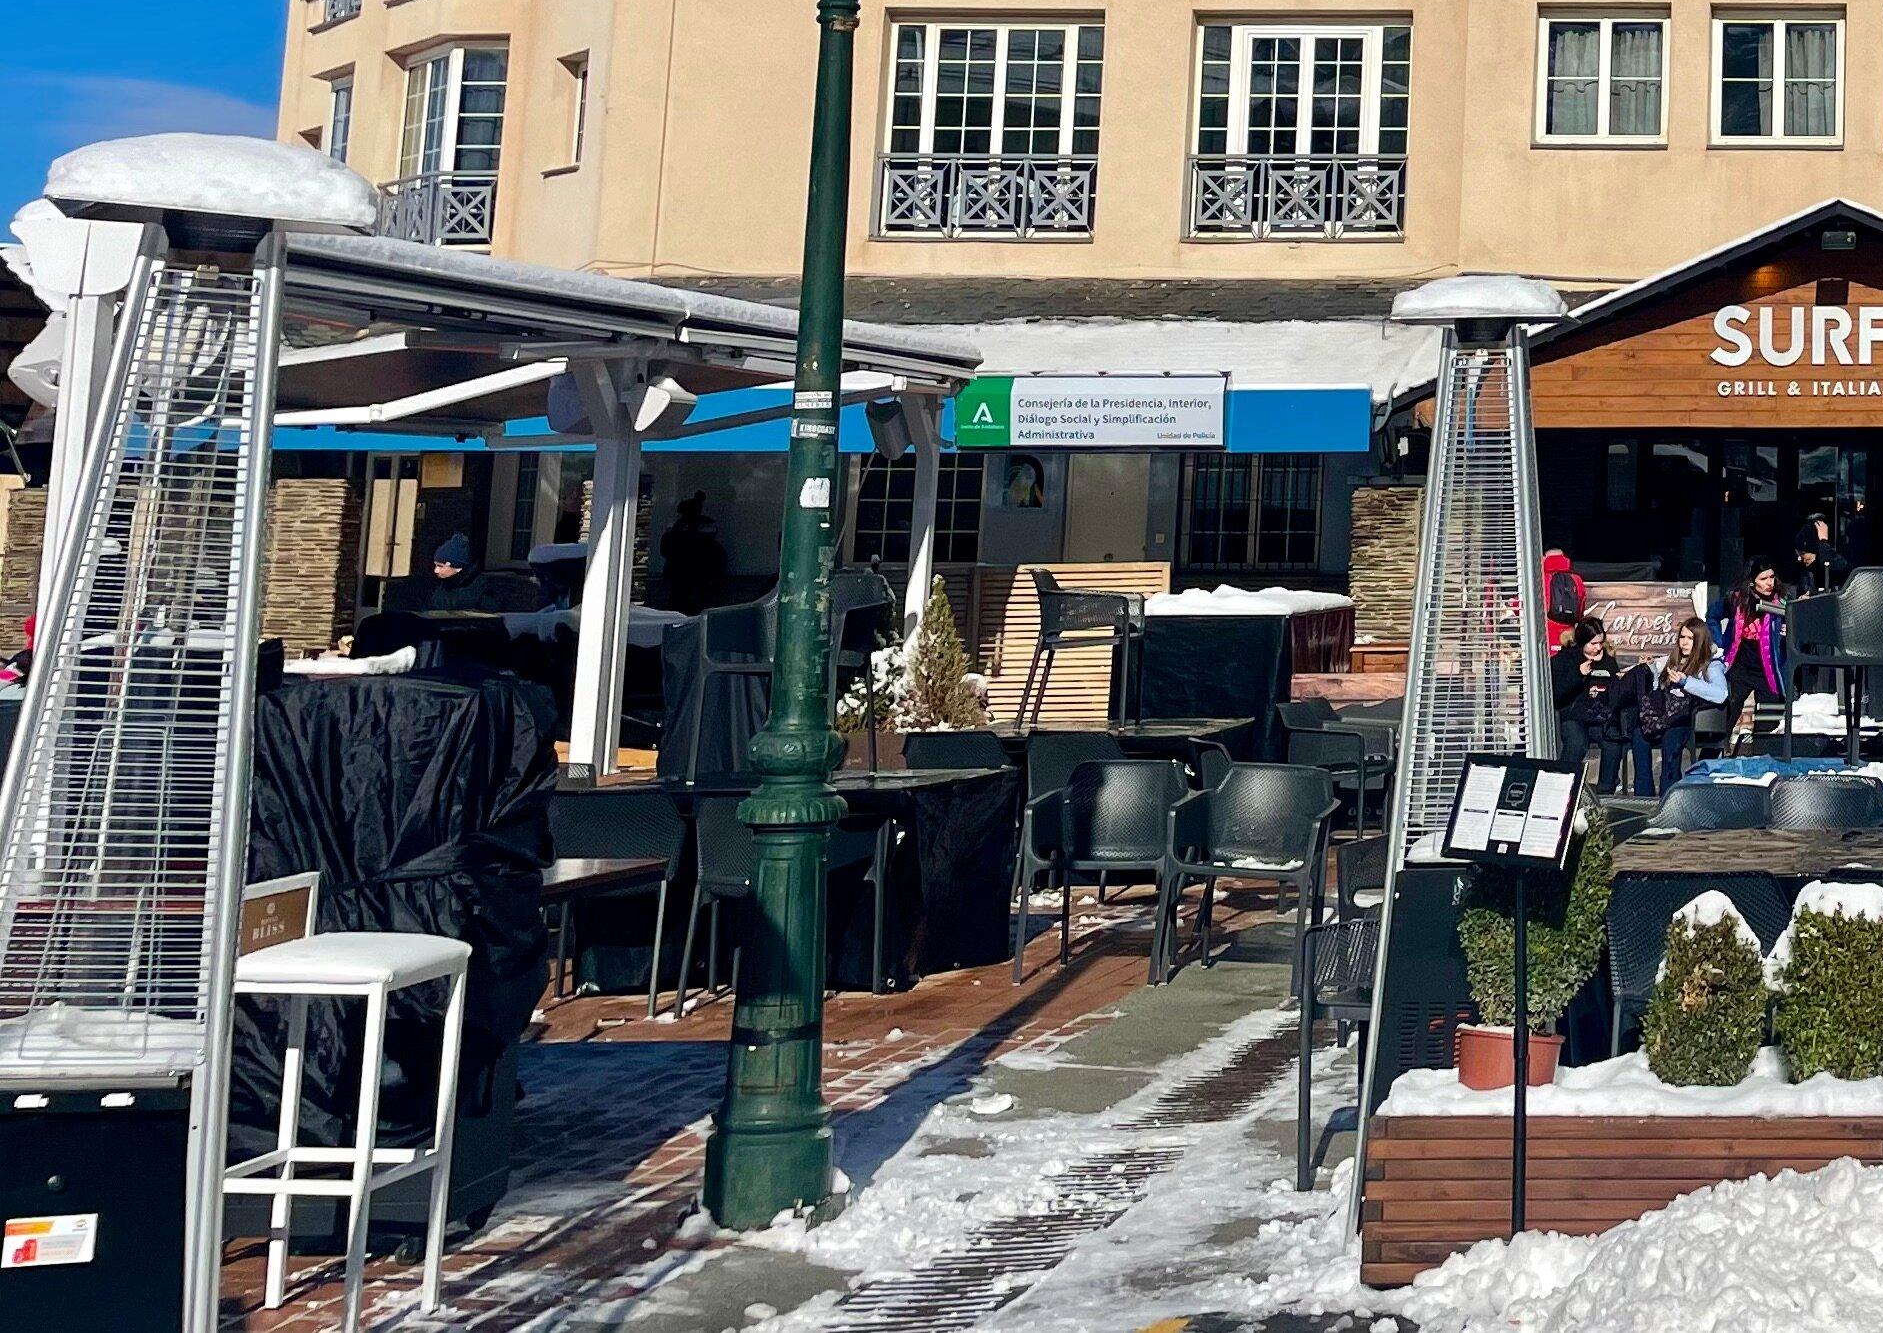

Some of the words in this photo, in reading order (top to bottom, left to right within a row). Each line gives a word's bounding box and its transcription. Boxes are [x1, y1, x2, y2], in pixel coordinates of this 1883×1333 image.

[1717, 380, 1777, 396] GRILL
[1787, 380, 1801, 396] &
[1017, 397, 1073, 411] Consejería
[1074, 398, 1089, 409] de
[1090, 398, 1100, 409] la
[1102, 398, 1166, 411] Presidencia,
[1168, 398, 1212, 410] Interior,
[1017, 413, 1058, 427] Diálogo
[1059, 414, 1092, 424] Social
[1093, 416, 1101, 427] y
[1102, 413, 1177, 427] Simplificación
[1017, 429, 1095, 440] Administrativa
